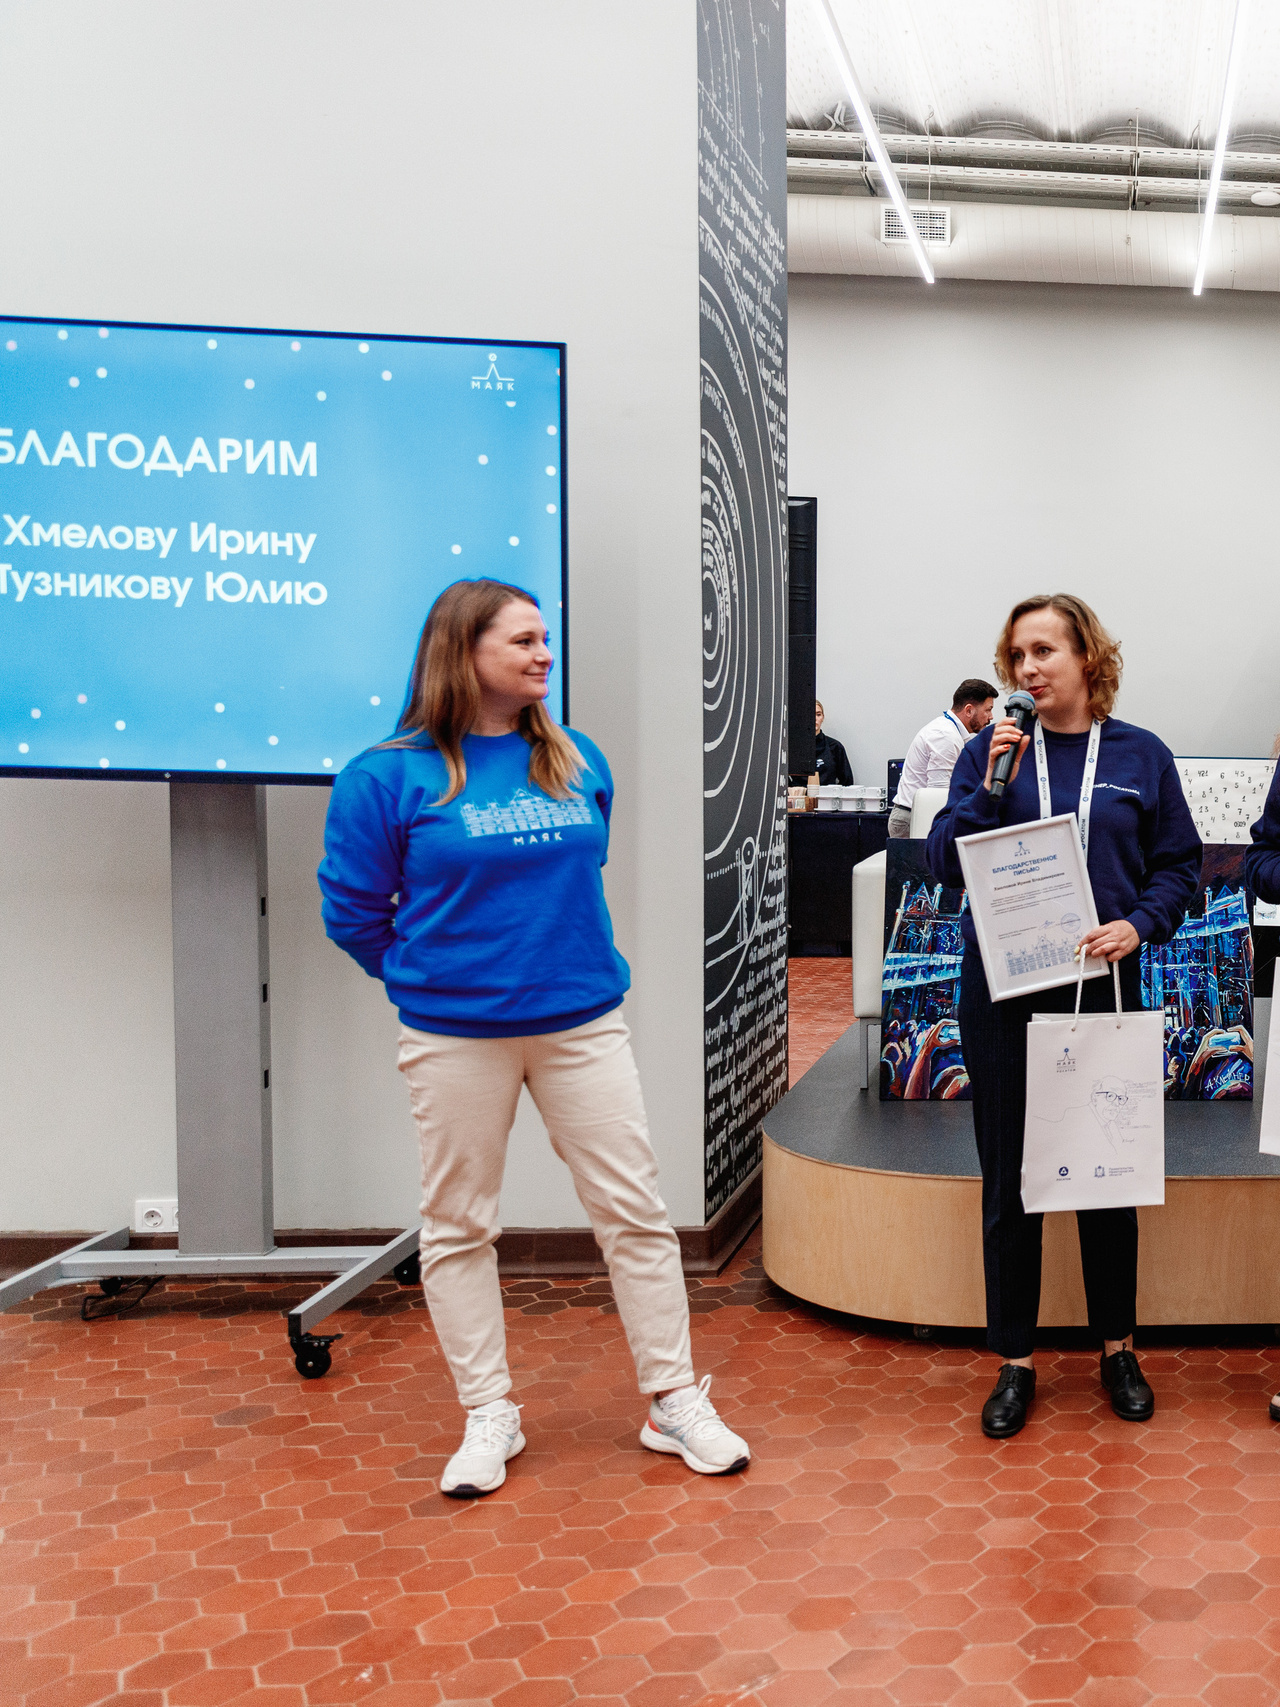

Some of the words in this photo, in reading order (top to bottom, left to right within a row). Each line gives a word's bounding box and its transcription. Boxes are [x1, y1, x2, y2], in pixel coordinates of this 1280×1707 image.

[471, 381, 514, 391] МАЯК
[0, 428, 319, 478] БЛАГОДАРИМ
[3, 514, 178, 559] Хмелову
[190, 521, 317, 563] Ирину
[0, 563, 193, 608] Тузникову
[206, 571, 328, 606] Юлию
[513, 831, 563, 846] МАЯК
[992, 854, 1057, 873] БЛАГОДАРСТВЕННОЕ
[1013, 866, 1040, 876] ПИСЬМО
